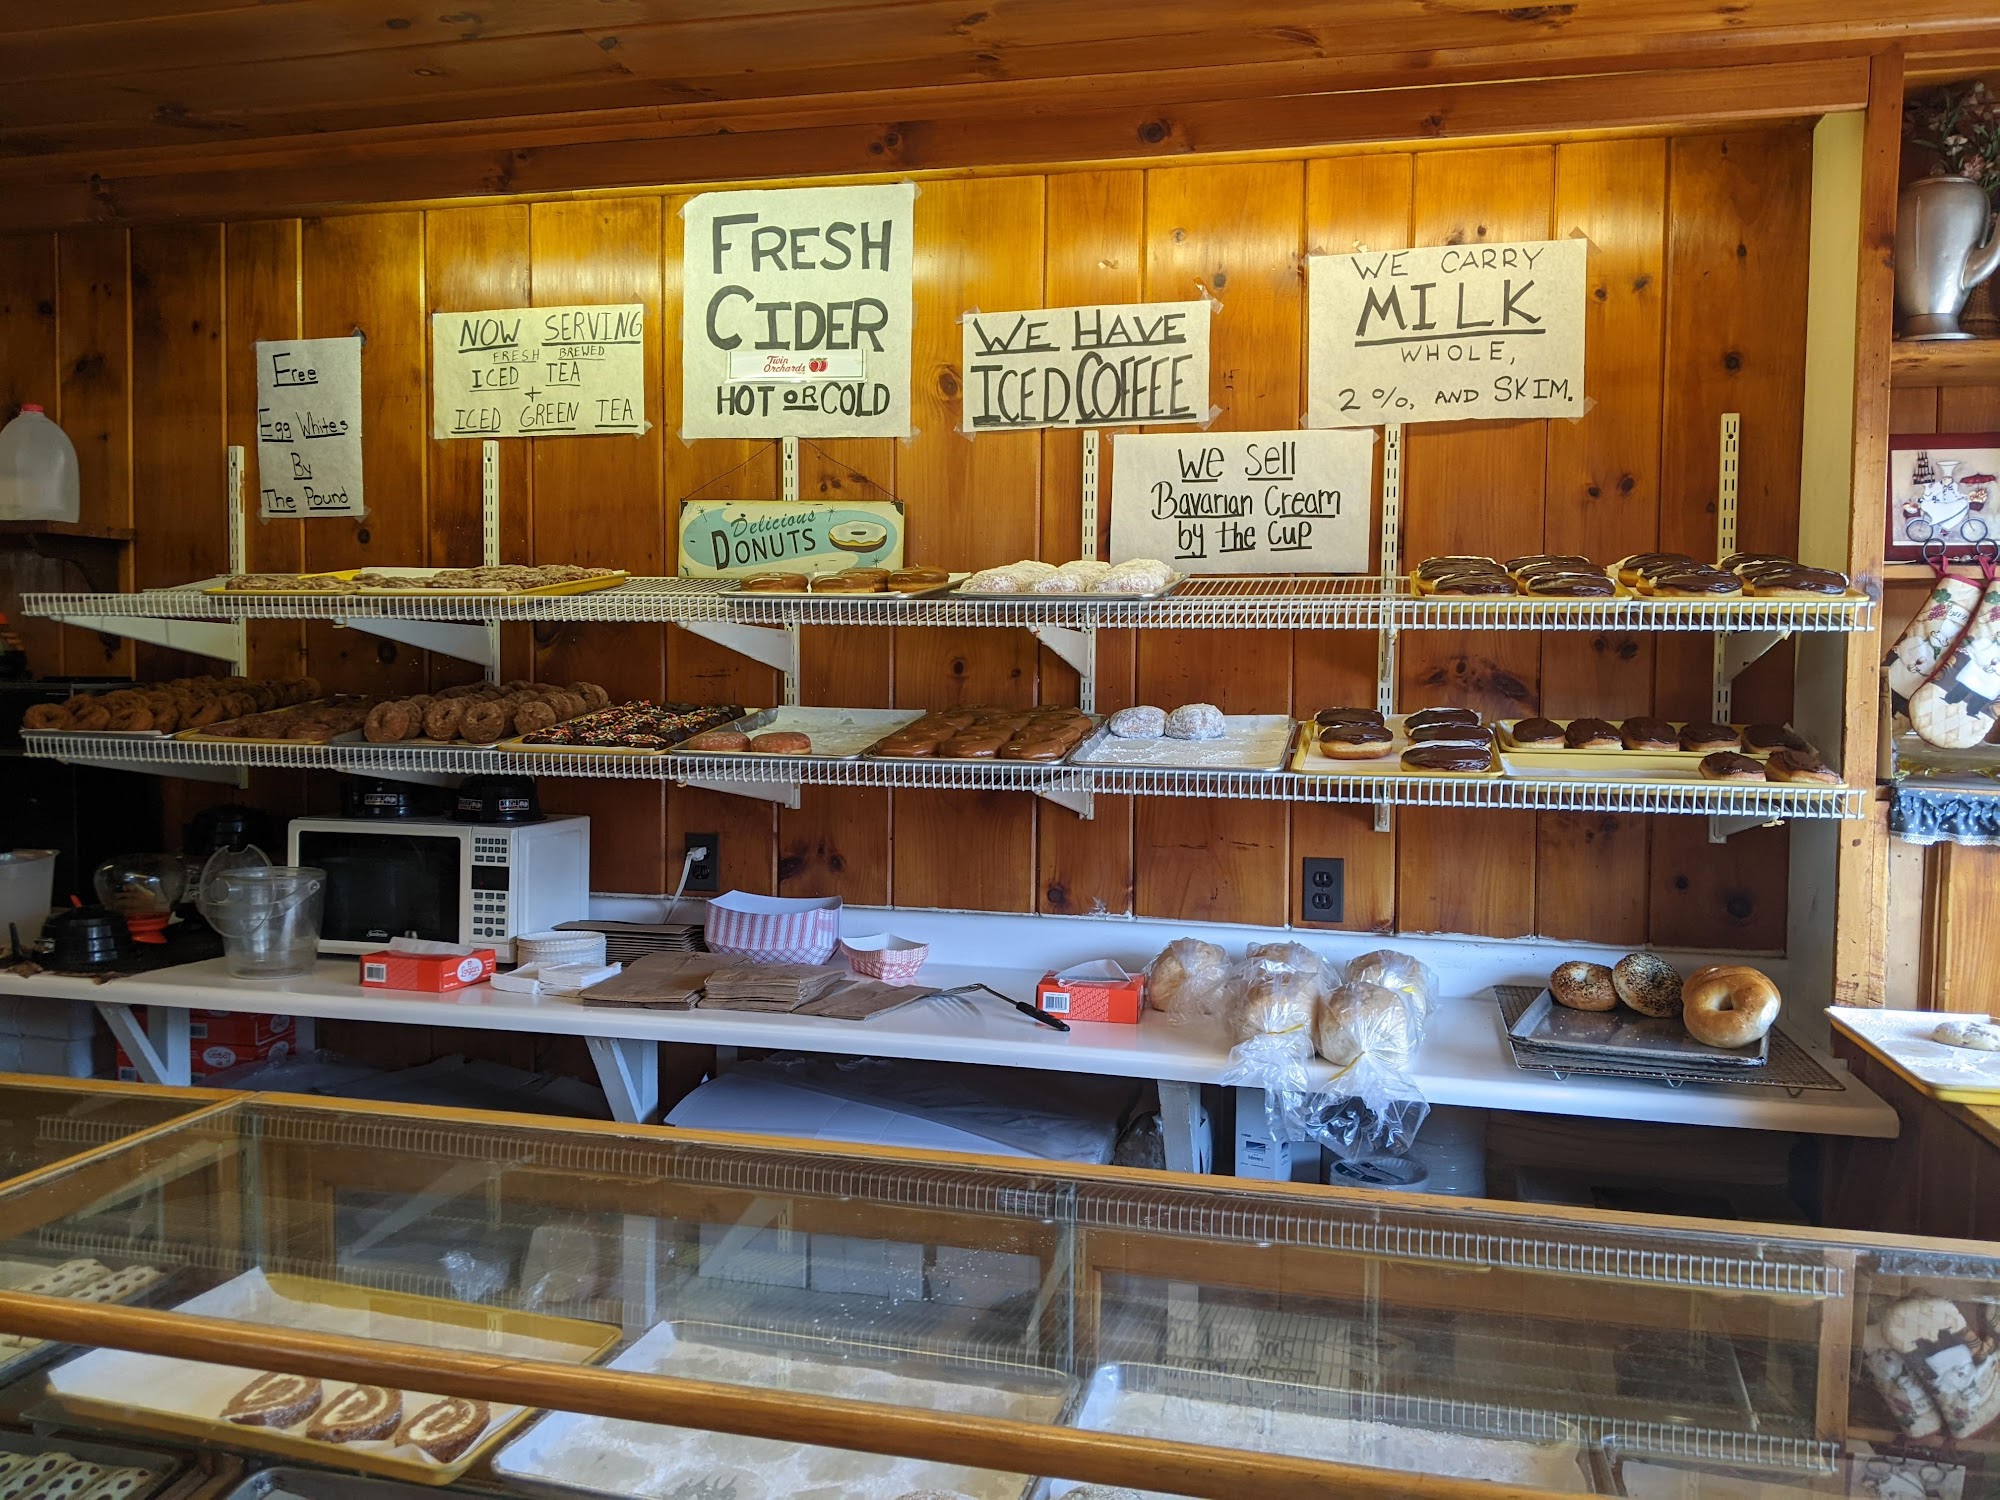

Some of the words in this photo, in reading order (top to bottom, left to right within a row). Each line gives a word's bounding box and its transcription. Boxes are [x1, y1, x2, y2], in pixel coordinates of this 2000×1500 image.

[712, 213, 892, 274] FRESH
[1351, 251, 1409, 279] WE
[1441, 247, 1544, 273] CARRY
[706, 285, 888, 352] CIDER
[1355, 279, 1542, 337] MILK
[459, 318, 521, 347] NOW
[544, 312, 642, 341] SERVING
[973, 314, 1051, 352] WE
[1074, 309, 1186, 347] HAVE
[274, 353, 317, 381] Free
[493, 349, 540, 362] FRESH
[558, 346, 605, 359] BREWED
[763, 363, 806, 374] Orchards
[767, 355, 788, 364] Twin
[1400, 341, 1515, 365] WHOLE,
[472, 366, 519, 387] ICED
[546, 362, 581, 383] TEA
[970, 365, 1070, 423] ICED
[1076, 351, 1193, 420] COFFEE
[1435, 390, 1479, 404] AND
[1494, 376, 1573, 402] SKIM.
[454, 407, 501, 431] ICED
[519, 402, 580, 428] GREEN
[595, 398, 633, 423] TEA
[717, 385, 775, 416] HOT
[820, 382, 890, 416] COLD
[259, 408, 292, 438] Egg
[295, 412, 348, 436] Whites
[291, 453, 312, 478] By
[1244, 441, 1296, 477] Sell
[262, 489, 296, 509] The
[304, 486, 349, 506] Pound
[1151, 481, 1253, 519] Bavarian
[1265, 485, 1341, 516] Cream
[731, 510, 816, 538] Delicious
[1178, 520, 1204, 556] by
[1215, 521, 1256, 549] the
[1268, 520, 1312, 548] Cup
[711, 528, 816, 571] DONUTS
